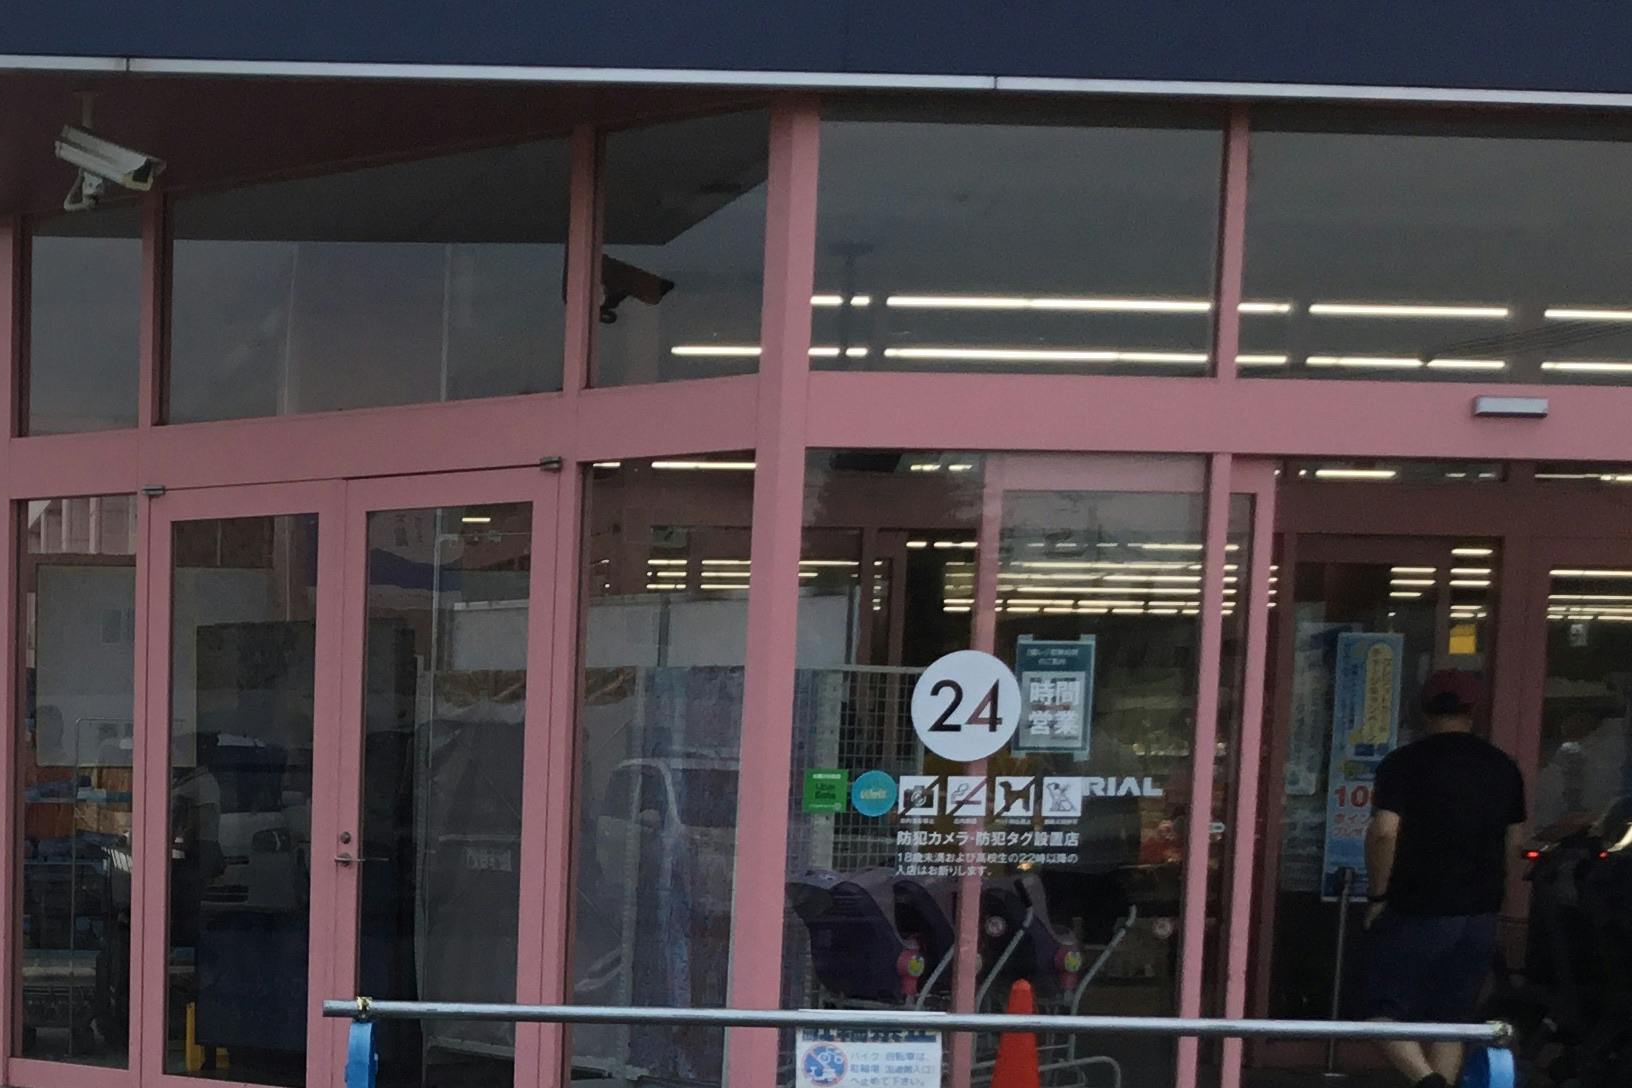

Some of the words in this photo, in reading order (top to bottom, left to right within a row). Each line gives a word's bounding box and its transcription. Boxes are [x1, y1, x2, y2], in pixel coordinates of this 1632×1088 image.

[1029, 681, 1081, 705] 時間
[928, 678, 1003, 733] 24
[1028, 709, 1079, 735] 営業
[1082, 776, 1163, 796] RIAL
[1334, 784, 1376, 807] 10
